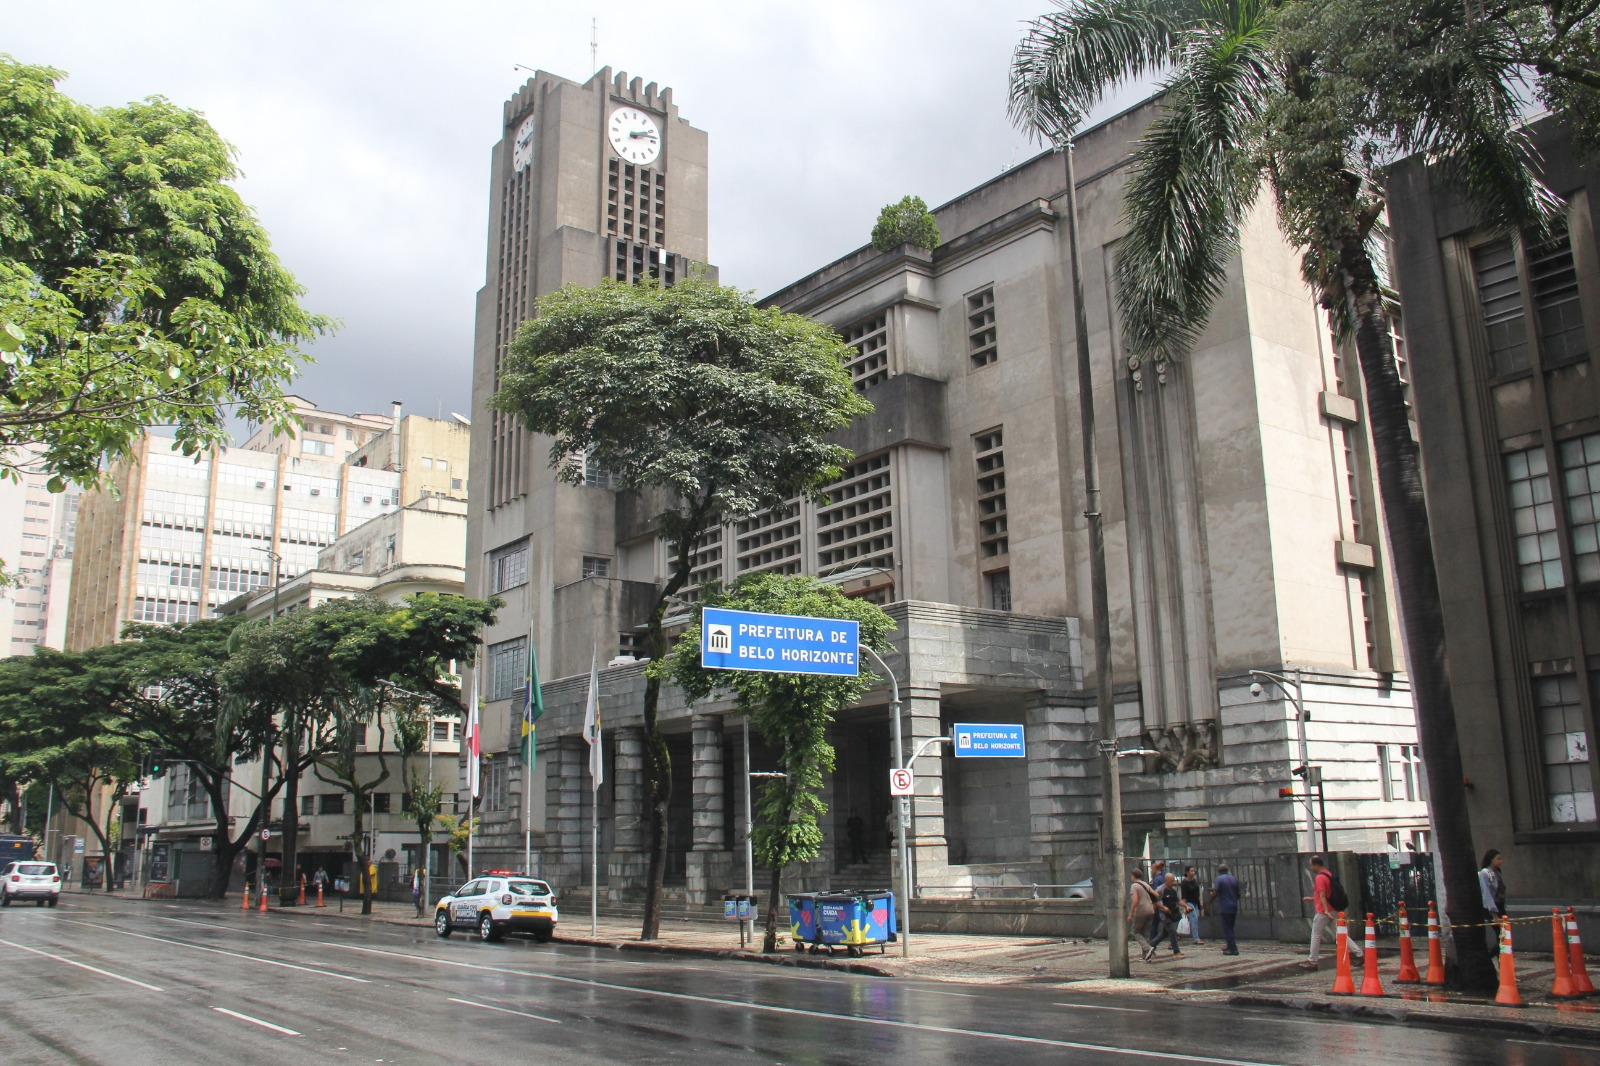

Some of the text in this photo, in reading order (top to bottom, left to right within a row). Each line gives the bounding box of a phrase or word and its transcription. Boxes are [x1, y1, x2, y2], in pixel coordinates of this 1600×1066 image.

[739, 623, 848, 644] PREFEITURA DE
[739, 645, 855, 665] BELO HORIZONTE
[990, 742, 1021, 750] HORIZONTE
